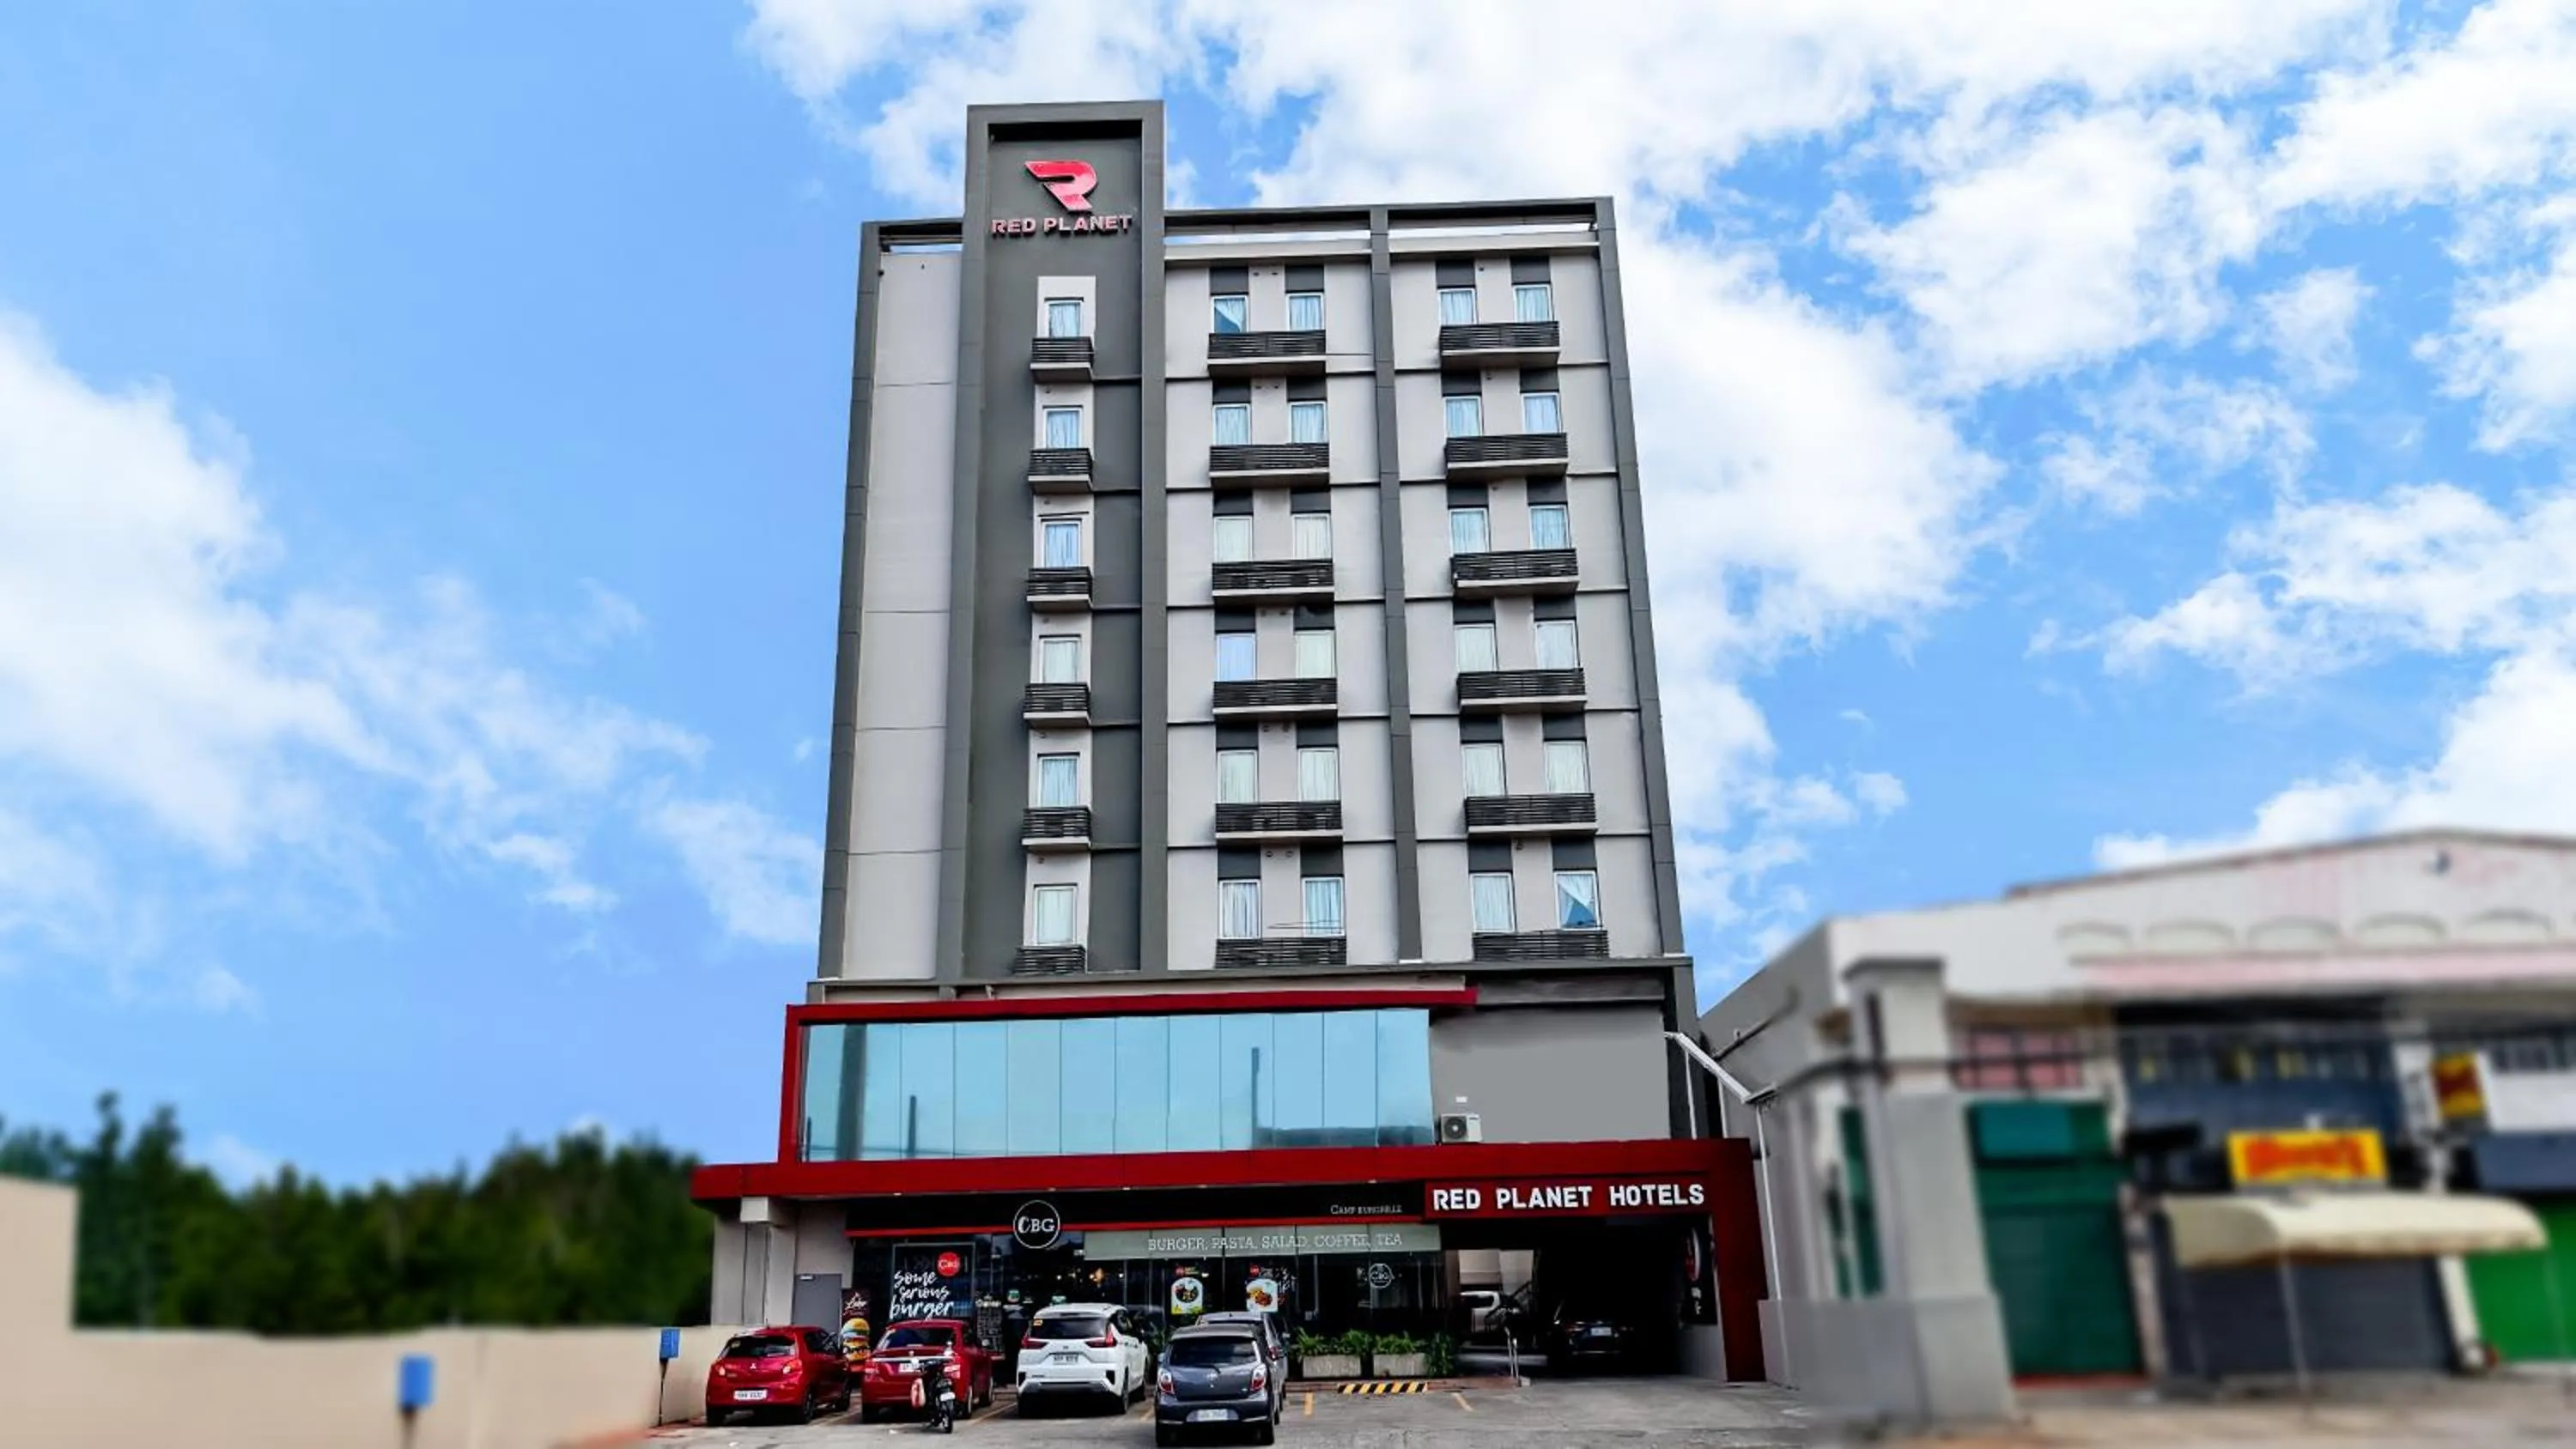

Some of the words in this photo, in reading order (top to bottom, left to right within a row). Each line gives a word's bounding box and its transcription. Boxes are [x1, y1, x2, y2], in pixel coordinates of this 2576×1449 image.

[991, 219, 1036, 234] RED
[1043, 215, 1133, 232] PLANET
[1432, 1188, 1481, 1210] RED
[1496, 1185, 1592, 1209] PLANET
[1608, 1184, 1704, 1206] HOTELS
[1018, 1216, 1055, 1234] CBG
[1376, 1234, 1402, 1246] TEA
[898, 1286, 951, 1303] serious
[889, 1294, 954, 1321] burger
